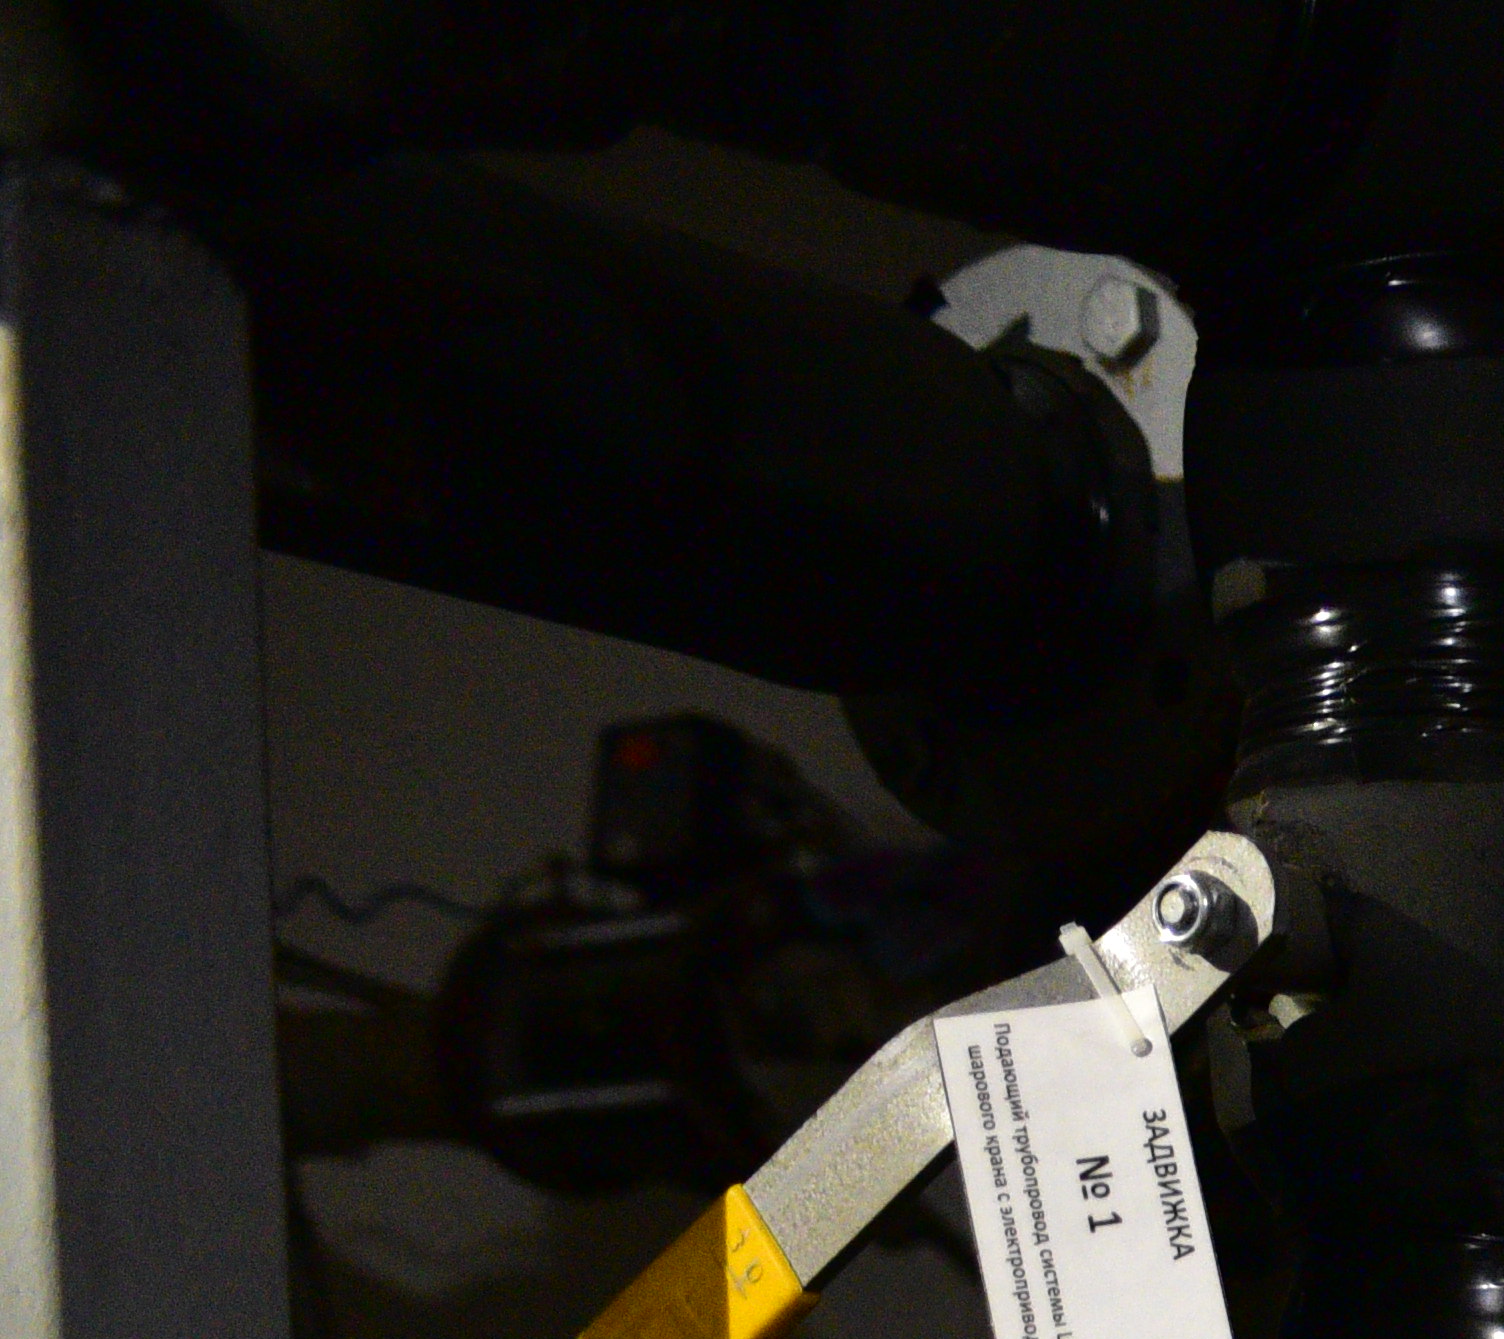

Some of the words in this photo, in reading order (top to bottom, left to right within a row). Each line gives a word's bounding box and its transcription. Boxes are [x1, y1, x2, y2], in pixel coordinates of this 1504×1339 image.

[968, 1045, 996, 1131] шарового
[984, 1134, 1008, 1187] крана
[999, 1193, 1010, 1201] с
[994, 1022, 1028, 1122] Подающий
[1012, 1124, 1048, 1245] трубопровод
[1038, 1249, 1065, 1327] системы
[1076, 1155, 1114, 1200] №
[1143, 1109, 1195, 1260] ЗАДВИЖКА
[1088, 1211, 1123, 1233] 1
